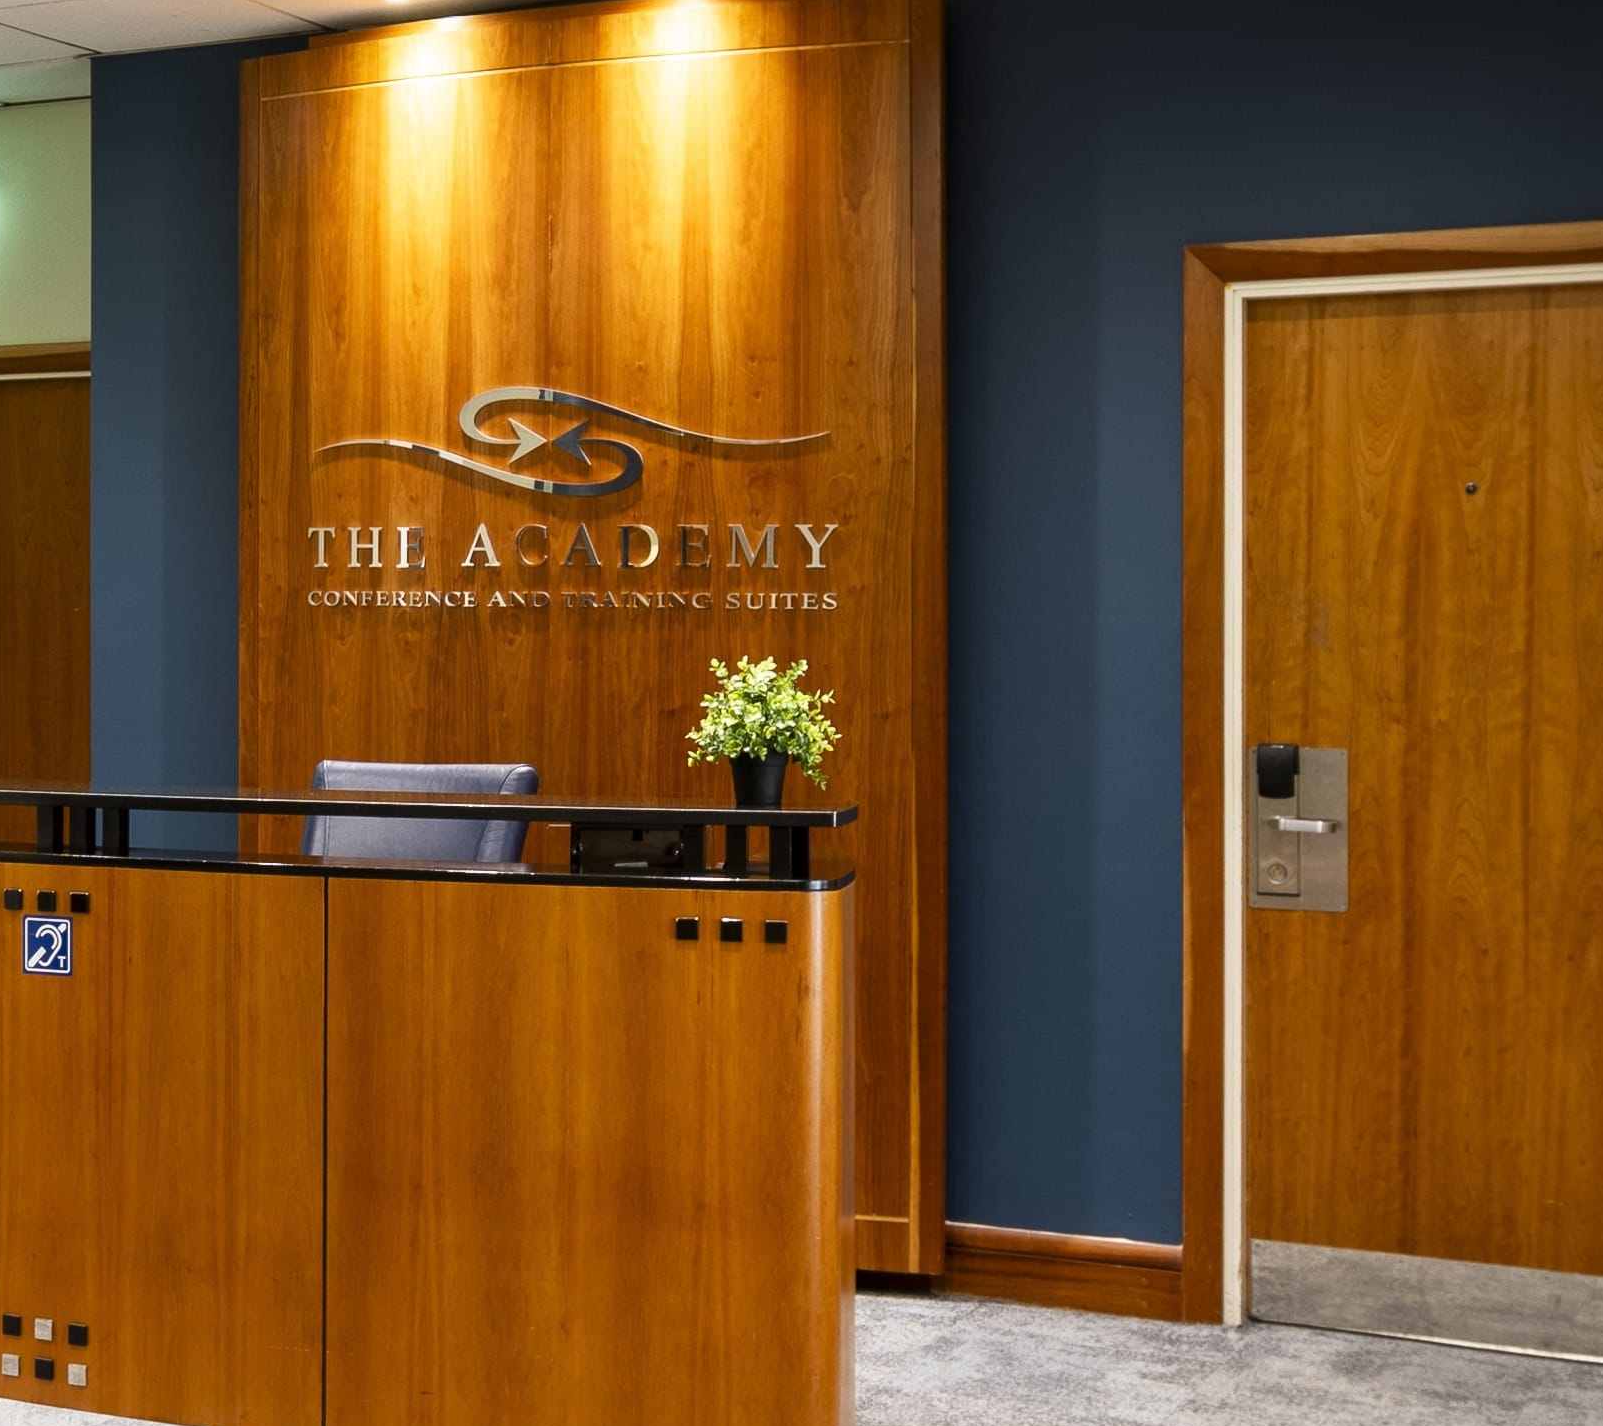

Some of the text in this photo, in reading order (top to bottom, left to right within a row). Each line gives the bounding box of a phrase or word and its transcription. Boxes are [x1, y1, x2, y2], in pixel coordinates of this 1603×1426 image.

[308, 522, 840, 569] THE ACADEMY
[308, 589, 839, 611] CONFERENCE AND TRAINING SUITES
